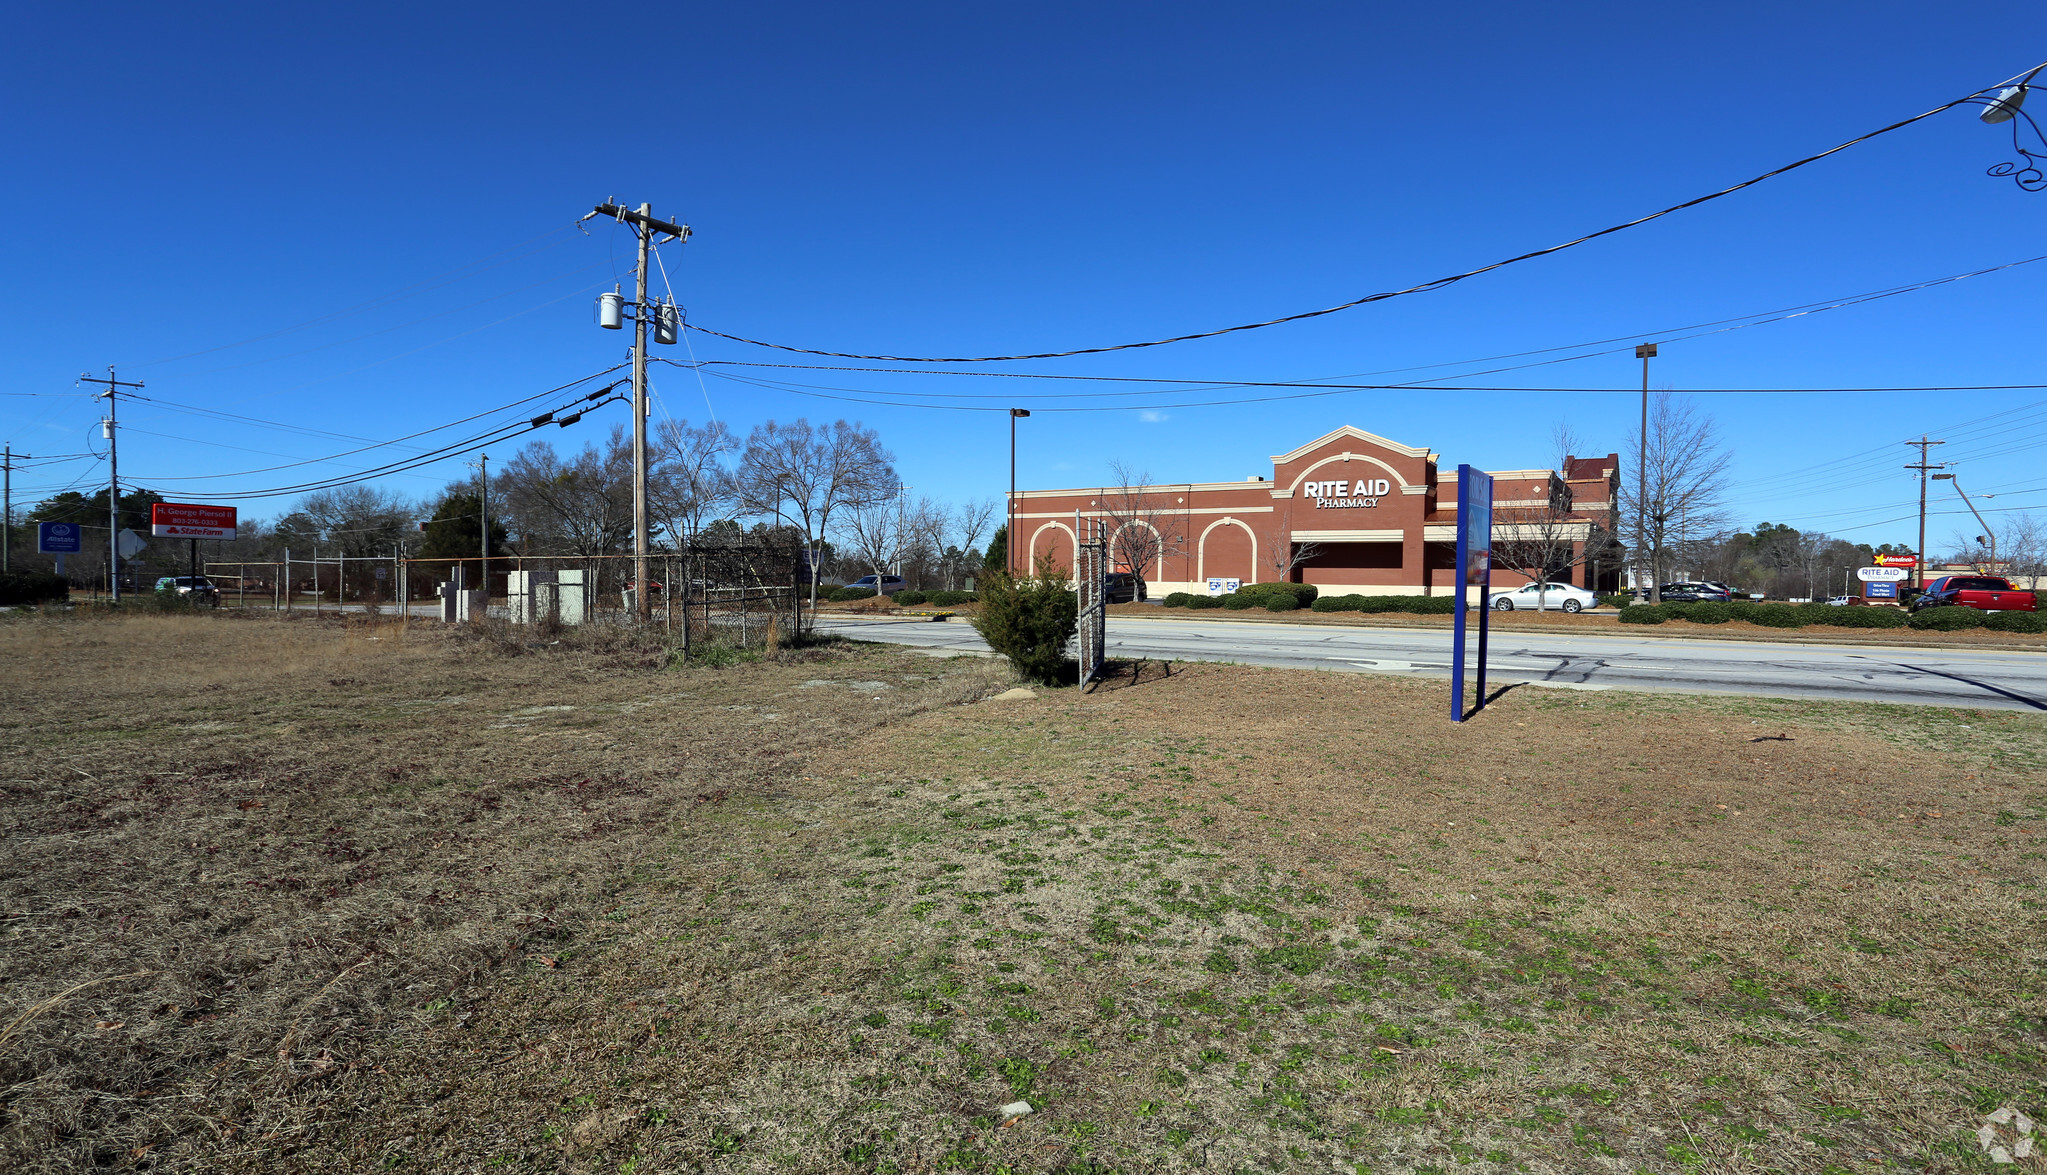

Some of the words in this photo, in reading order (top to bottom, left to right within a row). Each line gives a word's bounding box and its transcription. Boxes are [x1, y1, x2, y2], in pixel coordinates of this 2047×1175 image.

[1304, 480, 1349, 498] RITE
[1352, 479, 1390, 497] AID
[1316, 497, 1378, 509] PHARMACY
[157, 507, 165, 515] H.
[168, 507, 197, 517] George
[199, 509, 226, 518] Piersol
[172, 517, 218, 526] 803-276-0333
[1862, 568, 1882, 576] RITE
[1884, 568, 1900, 576] AID
